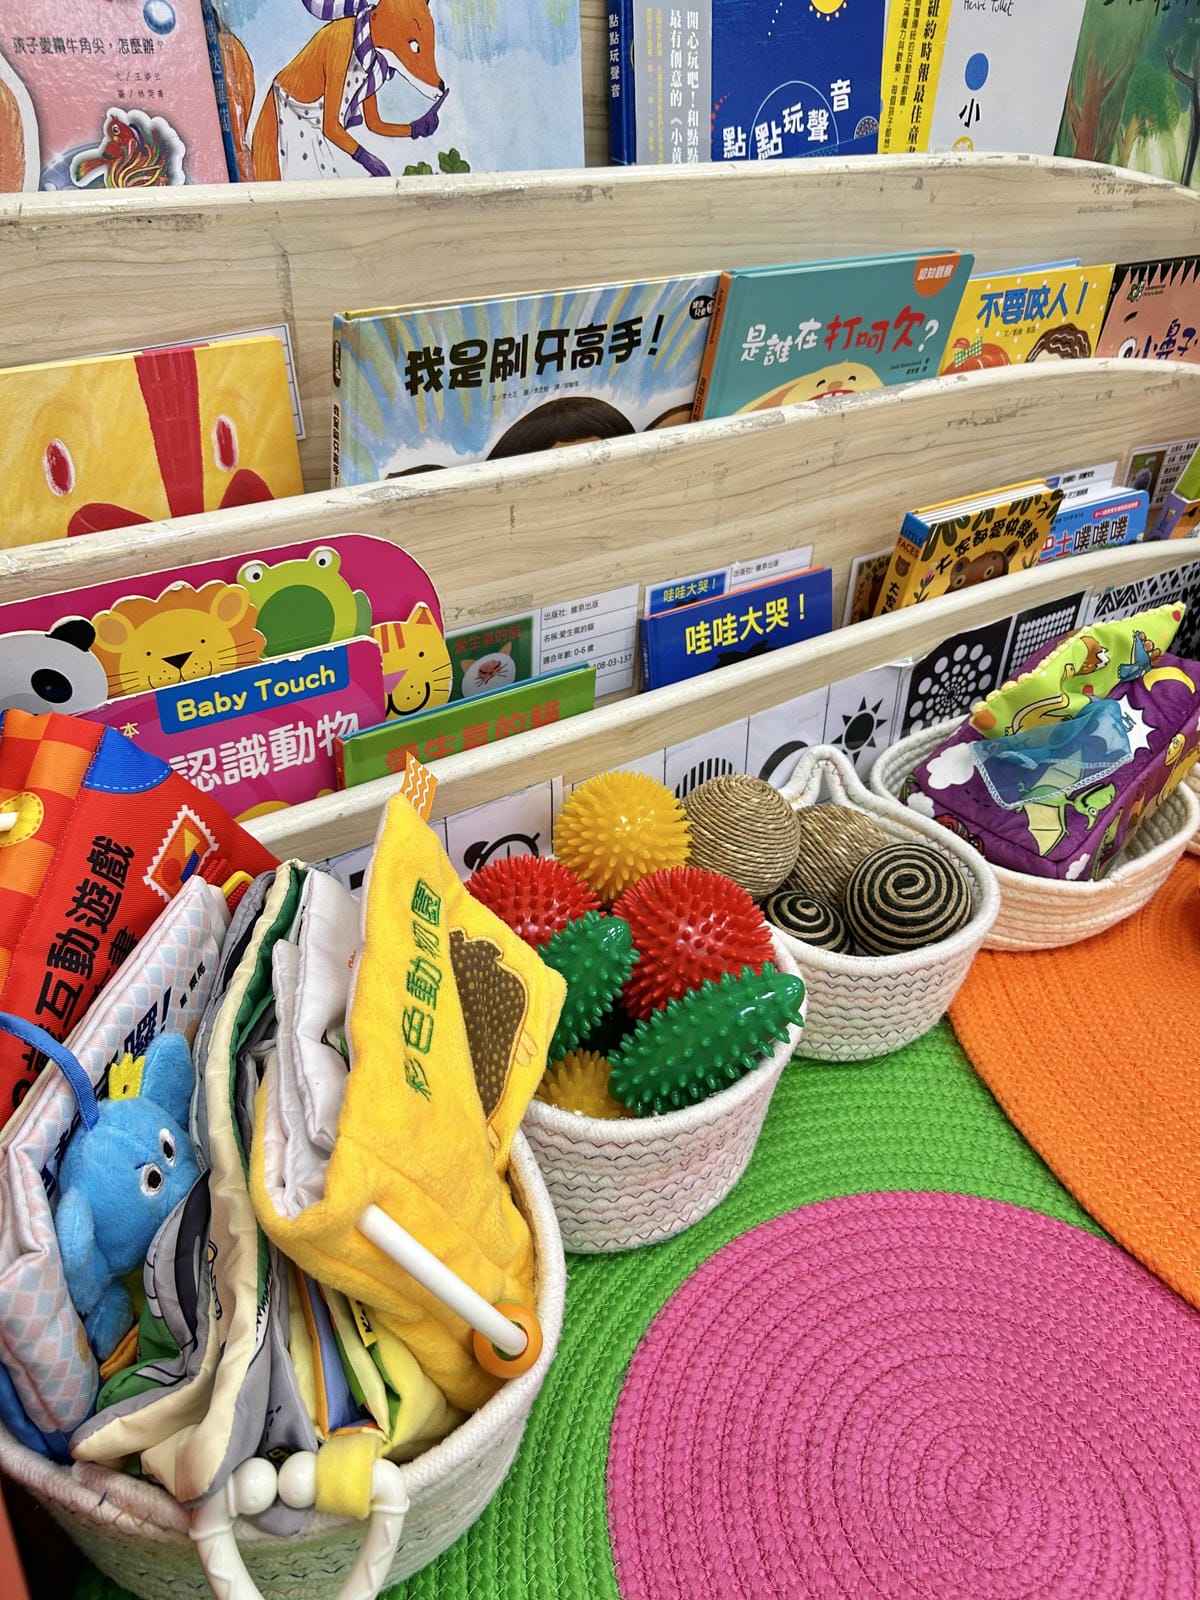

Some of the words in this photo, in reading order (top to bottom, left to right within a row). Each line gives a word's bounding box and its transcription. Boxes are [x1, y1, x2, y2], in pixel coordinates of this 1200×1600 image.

[608, 14, 621, 98] 點點玩聲音
[723, 79, 852, 159] 點點玩聲音
[976, 281, 1089, 328] 不要咬人!
[403, 314, 664, 396] 我是刷牙高手!
[740, 305, 939, 367] 是誰在打呵欠?
[896, 537, 920, 559] FACES
[544, 609, 567, 621] 出版社:
[663, 578, 717, 602] 哇哇大哭!
[685, 593, 805, 655] 哇哇大哭!
[176, 690, 247, 722] Baby
[254, 665, 335, 702] Touch
[169, 710, 359, 793] 認識動物
[402, 877, 443, 1102] 彩色動物園
